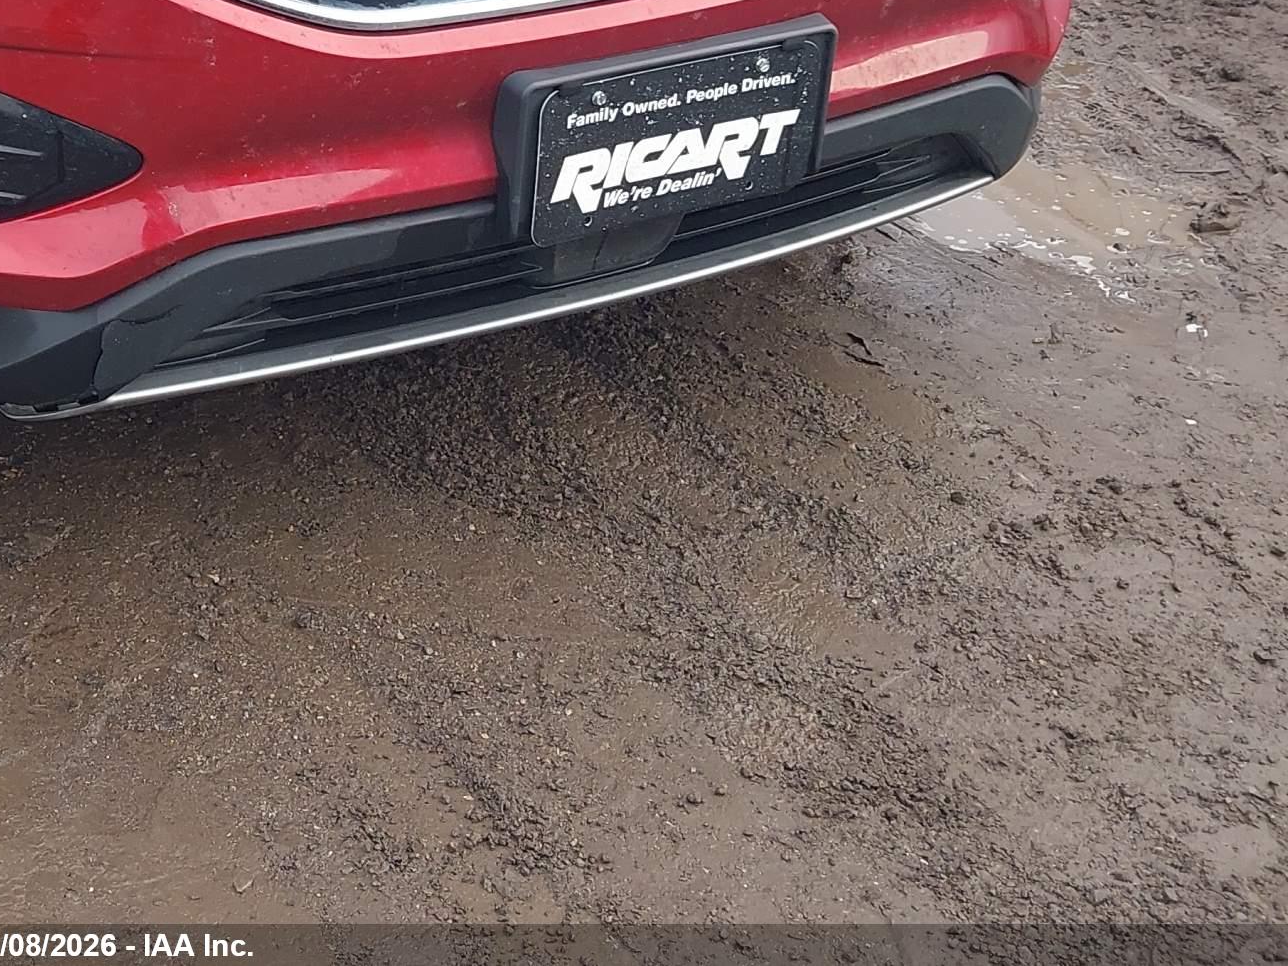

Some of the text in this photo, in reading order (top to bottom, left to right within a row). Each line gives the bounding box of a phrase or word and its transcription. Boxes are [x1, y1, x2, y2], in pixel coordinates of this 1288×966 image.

[566, 72, 796, 129] Family Owned. People Driven.
[549, 108, 801, 214] RICART
[603, 167, 722, 209] We're Dealin'
